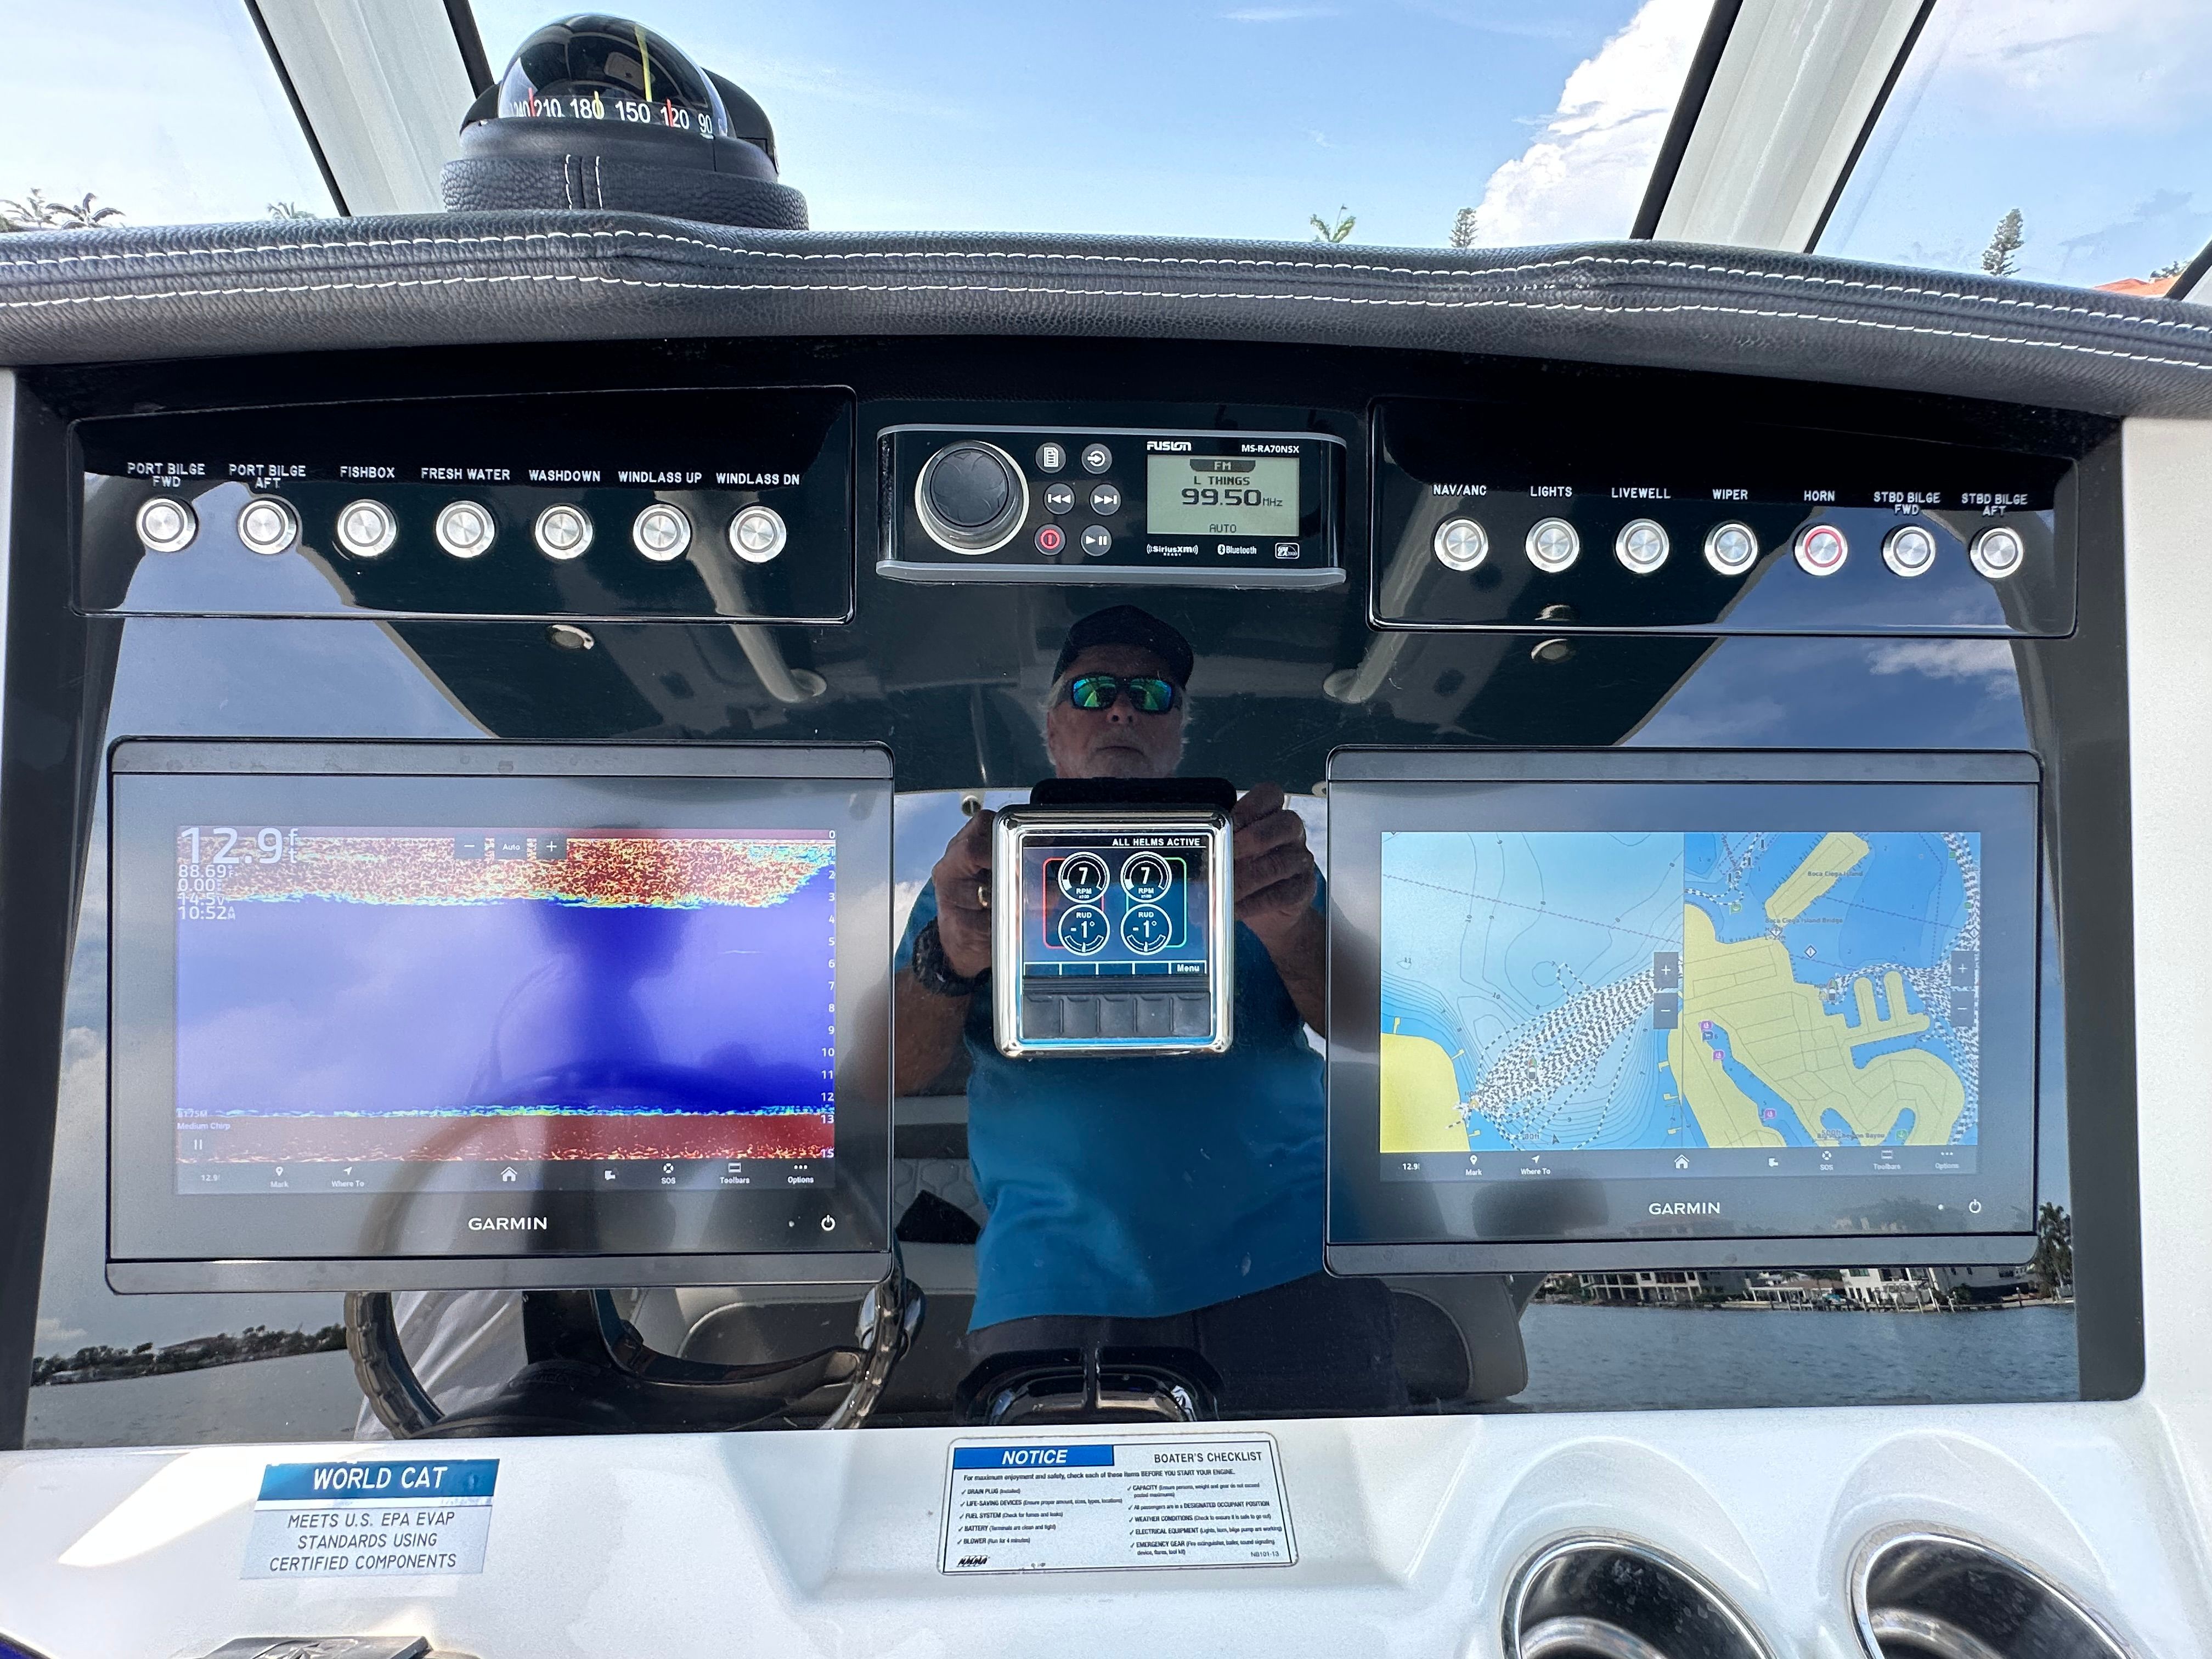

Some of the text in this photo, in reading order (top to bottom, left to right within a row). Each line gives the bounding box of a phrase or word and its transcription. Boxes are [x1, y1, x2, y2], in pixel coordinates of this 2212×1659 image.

[534, 99, 561, 117] 210
[571, 99, 605, 119] 180
[616, 101, 651, 123] 150
[660, 106, 690, 129] 120
[698, 113, 713, 134] 90
[1147, 441, 1192, 451] FUSION
[1242, 444, 1299, 453] MS-RA70NSX
[127, 462, 205, 476] PORT BILGE
[229, 464, 306, 477] PORT BILGE
[1214, 461, 1232, 471] FM
[340, 466, 395, 478] FISHBOX
[421, 467, 510, 481] FRESH WATER
[528, 470, 601, 482] WASHDOWN
[618, 470, 702, 483] WINDLASS UP
[152, 476, 181, 488] FWD
[255, 478, 280, 489] AFT
[716, 472, 800, 486] WINDLASS DN
[1194, 476, 1250, 486] L THINGS
[1433, 484, 1487, 496] NAV/ANC
[1530, 486, 1572, 498] LIGHTS
[1611, 487, 1672, 499] LIVEWELL
[1712, 489, 1748, 500] WIPER
[1181, 488, 1283, 506] 99.50 MHz
[1804, 490, 1836, 502] HORN
[1874, 492, 1941, 504] STBD BILGE
[1961, 493, 2028, 506] STBD BILGE
[1894, 504, 1920, 515] FWD
[1982, 506, 2007, 516] AFT
[1209, 523, 1237, 533] AUTO
[1225, 546, 1257, 555] Bluetooth
[829, 830, 836, 839] 0
[181, 827, 283, 864] 12.9
[1167, 838, 1200, 846] ACTIVE
[178, 865, 227, 878] 88.69
[828, 871, 836, 879] 2
[1079, 867, 1088, 884] 7
[1141, 867, 1150, 884] 7
[178, 878, 216, 891] 0.00
[828, 893, 835, 901] 3
[178, 906, 227, 920] 10:52
[828, 915, 835, 923] 4
[828, 938, 835, 946] 5
[828, 960, 836, 968] 6
[1177, 964, 1200, 972] Menu
[828, 981, 835, 990] 7
[828, 1004, 835, 1012] 8
[828, 1026, 835, 1034] 9
[822, 1048, 835, 1057] 10
[821, 1070, 834, 1079] 11
[821, 1092, 834, 1101] 12
[821, 1115, 834, 1124] 13
[210, 1123, 231, 1131] Chirp
[821, 1149, 834, 1158] 15
[720, 1176, 751, 1184] Toolbars
[787, 1176, 814, 1184] Options
[1649, 1202, 1720, 1215] GARMIN
[467, 1217, 548, 1231] GARMIN
[1002, 1449, 1068, 1465] NOTICE
[1154, 1452, 1262, 1463] BOATER'S CHECKLIST
[313, 1466, 448, 1491] WORLD CAT
[287, 1511, 455, 1528] MEETS U.S. EPA EVAP
[297, 1532, 438, 1550] STANDARDS USING
[269, 1553, 457, 1572] CERTIFIED COMPONENTS
